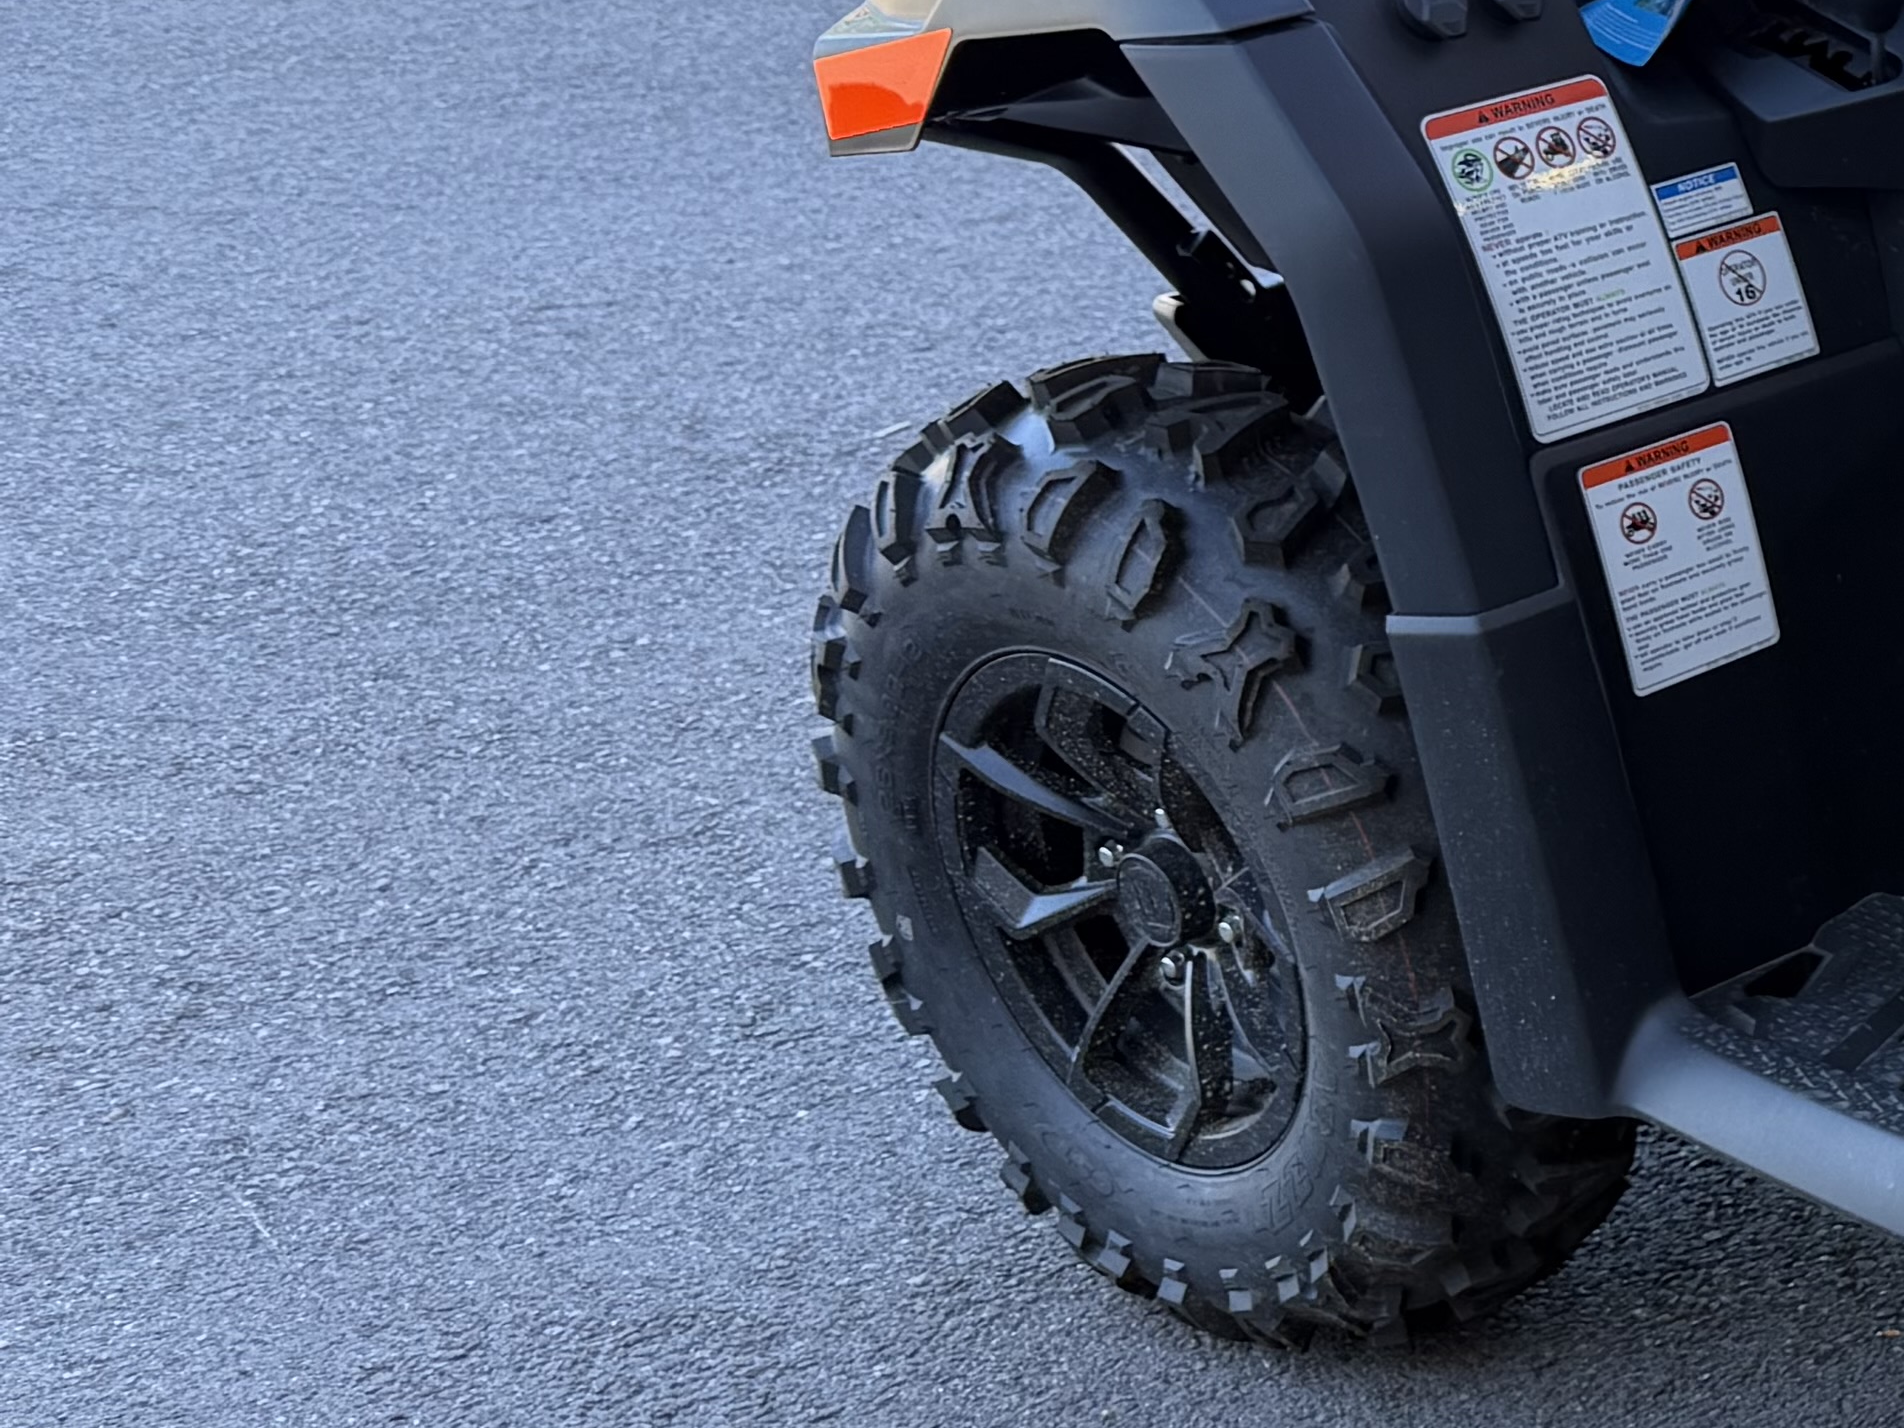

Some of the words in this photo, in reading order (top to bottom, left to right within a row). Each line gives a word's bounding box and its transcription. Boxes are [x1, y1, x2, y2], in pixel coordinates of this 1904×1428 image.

[1491, 93, 1555, 118] WARNING
[1676, 173, 1716, 192] NOTICE
[1707, 222, 1761, 248] WARNING
[1734, 283, 1756, 303] 16
[1636, 440, 1689, 468] WARNING
[1670, 456, 1701, 473] SAFETY
